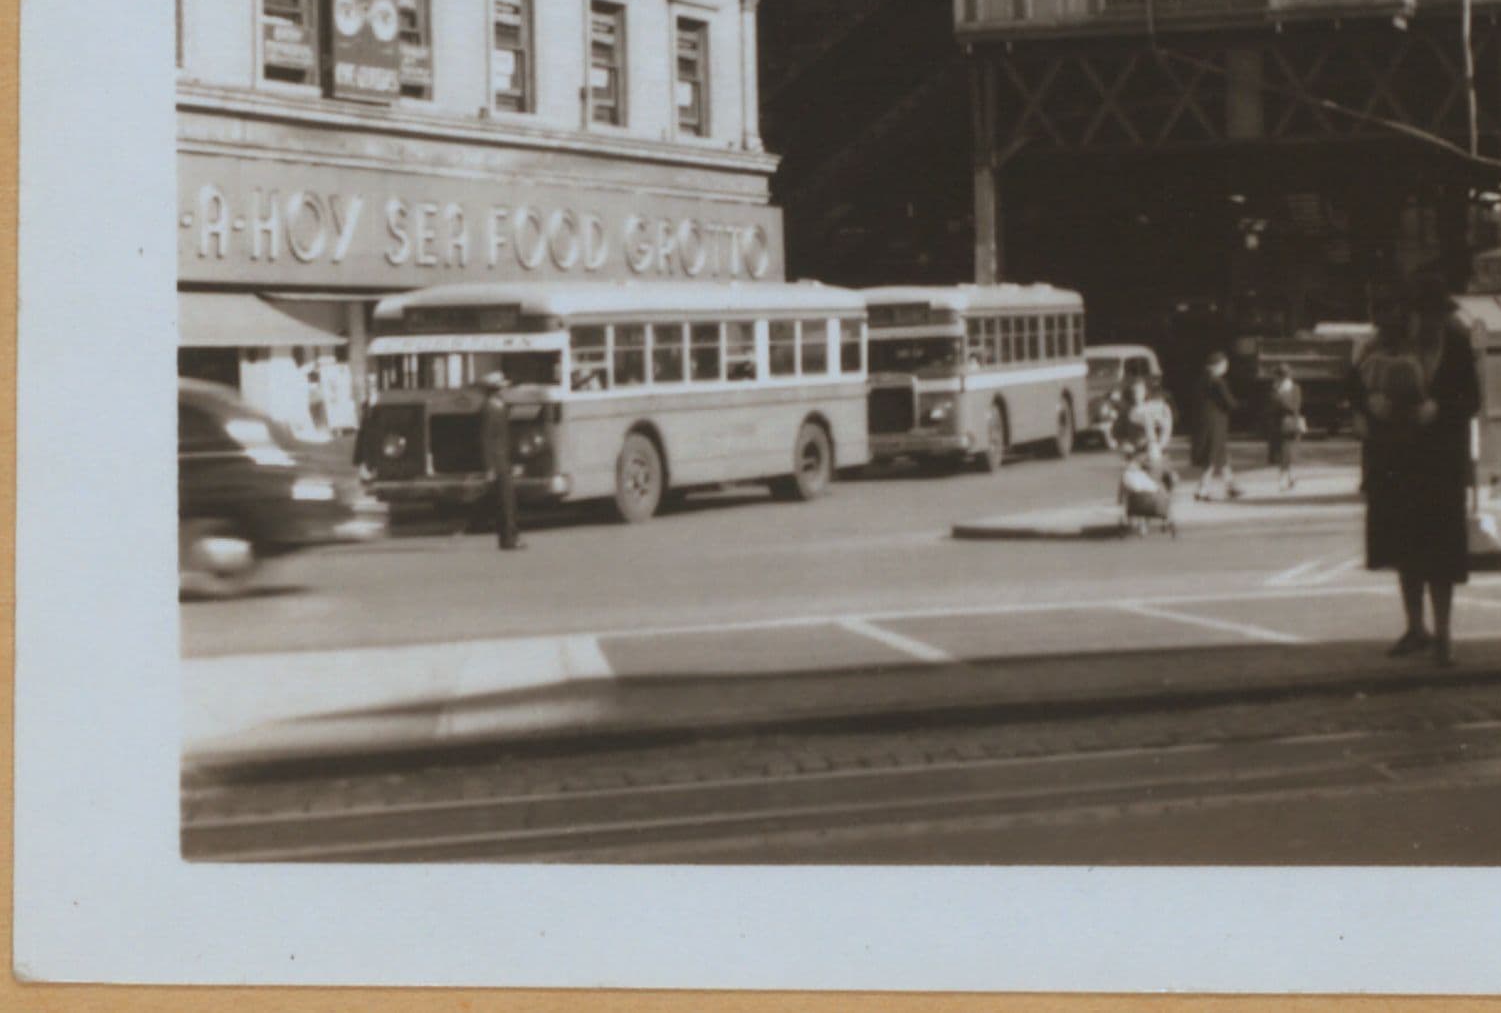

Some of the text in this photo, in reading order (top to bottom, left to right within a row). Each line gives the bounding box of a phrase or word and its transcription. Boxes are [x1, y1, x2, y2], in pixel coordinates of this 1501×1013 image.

[384, 194, 468, 271] SEA
[486, 203, 609, 274] FOOD
[621, 212, 771, 280] GROTTO
